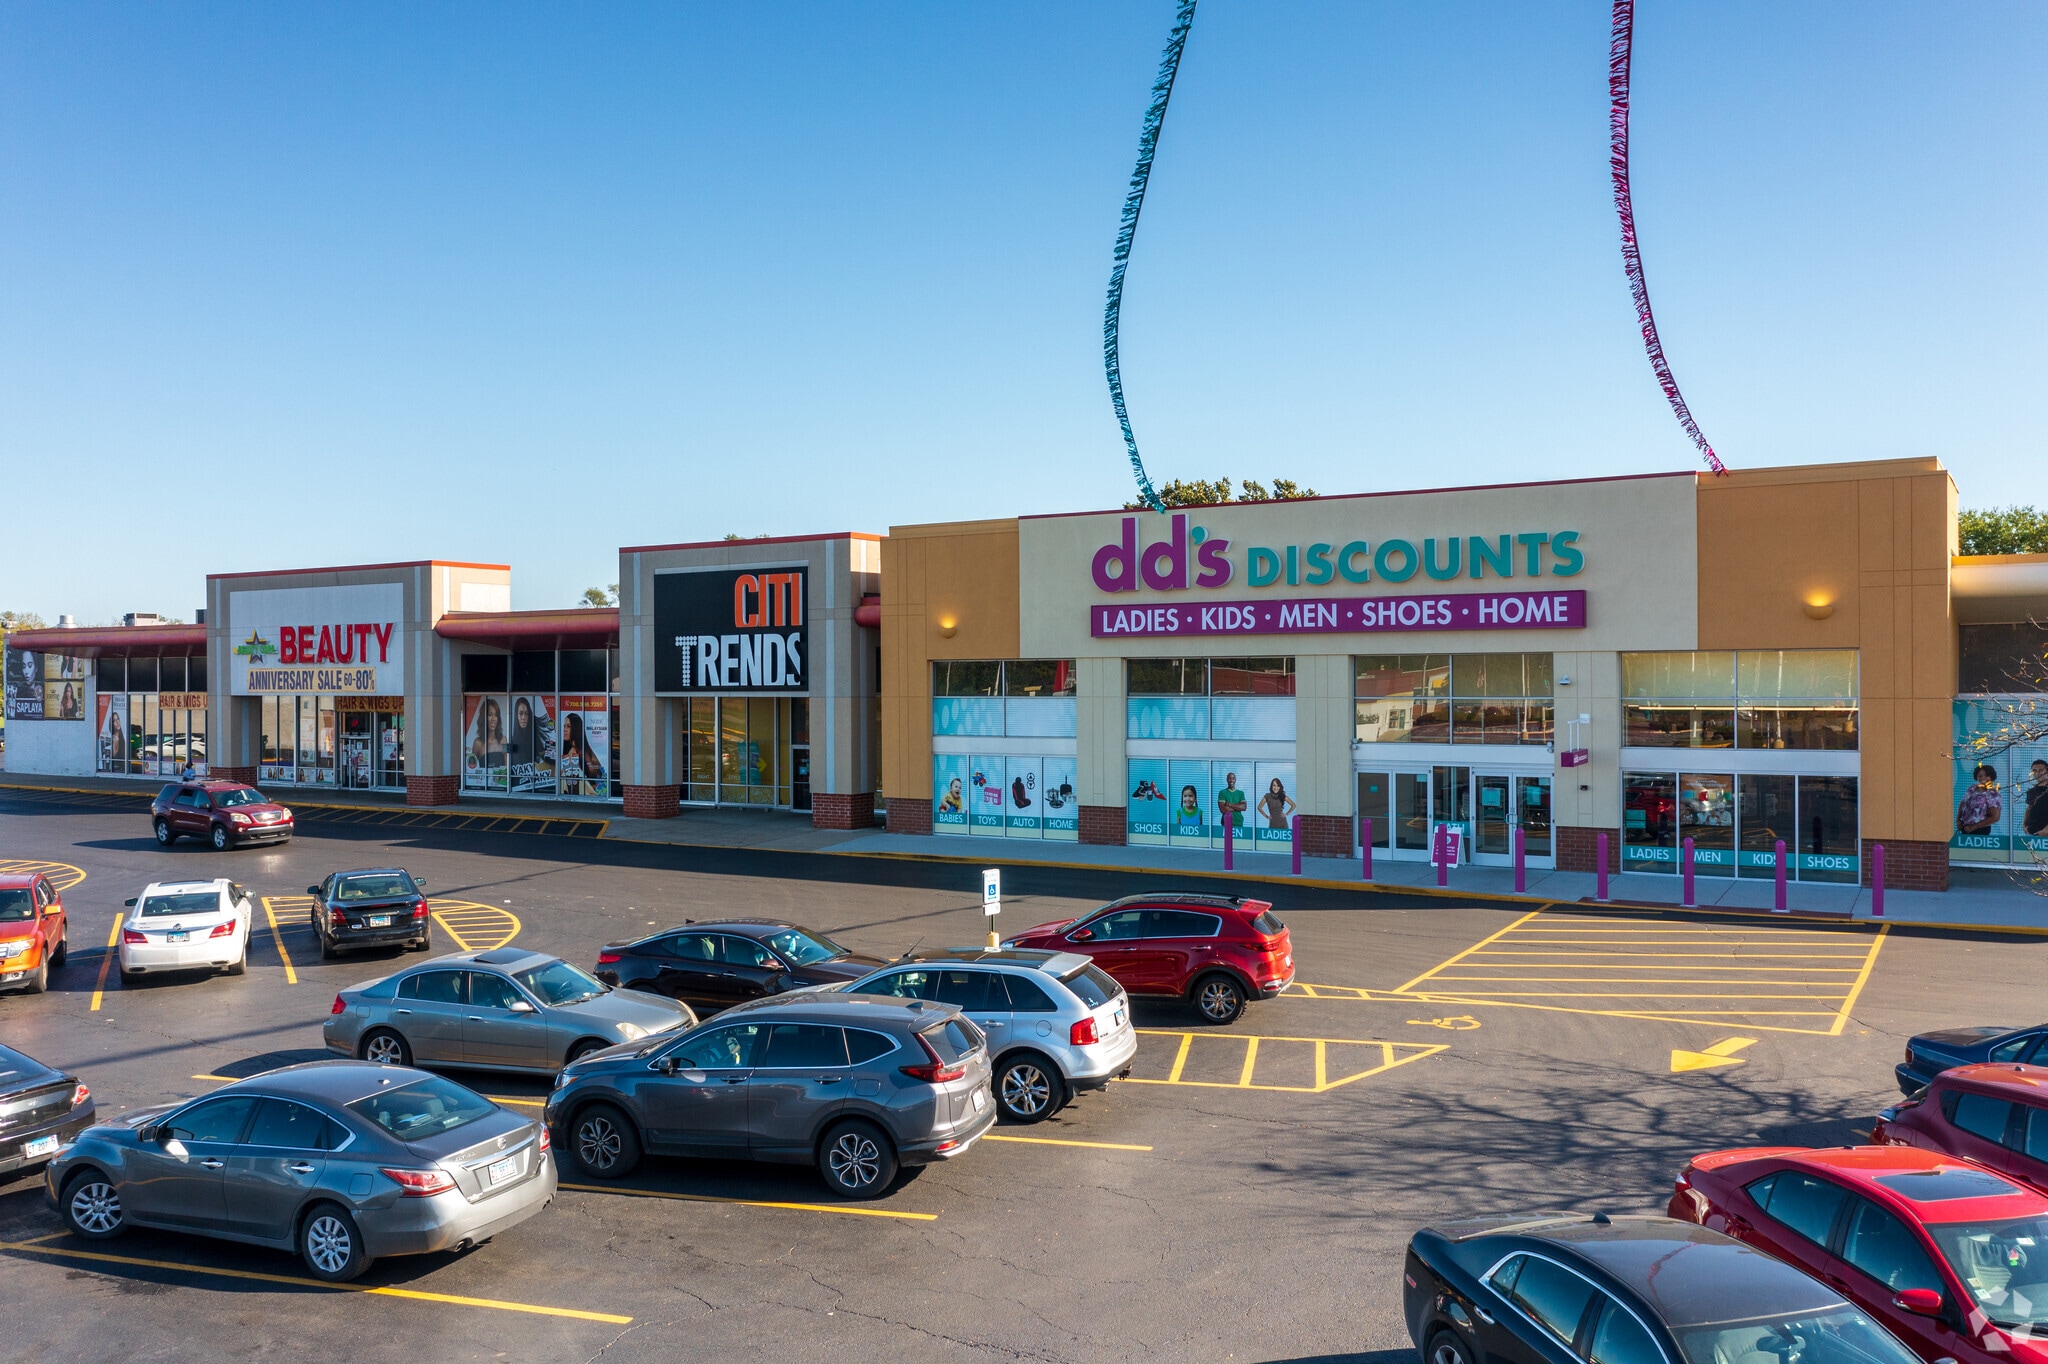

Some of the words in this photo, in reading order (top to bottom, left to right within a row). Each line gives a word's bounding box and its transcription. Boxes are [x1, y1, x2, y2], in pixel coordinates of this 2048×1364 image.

[1091, 514, 1235, 593] dd's
[1247, 531, 1585, 587] DISCOUNTS
[735, 572, 803, 628] CITI
[1103, 608, 1179, 633] LADIES
[1201, 605, 1256, 630] KIDS
[1279, 603, 1337, 628] MEN
[1362, 600, 1451, 626] SHOES
[1479, 596, 1568, 624] HOME
[280, 623, 394, 664] BEAUTY
[675, 632, 801, 687] TRENDS
[249, 670, 314, 690] ANNIVERSARY
[318, 670, 342, 690] SALE
[160, 695, 175, 708] HAIR
[176, 695, 181, 708] &
[184, 695, 200, 708] WIGS
[337, 696, 356, 709] HAIR
[368, 696, 390, 709] WIGS
[940, 814, 962, 824] BABIES
[978, 816, 996, 825] TOYS
[1013, 818, 1034, 827] AUTO
[1049, 820, 1073, 829] HOME
[1134, 823, 1162, 834] SHOES
[1180, 826, 1199, 836] KIDS
[1223, 828, 1243, 838] EN
[1262, 829, 1292, 840] LADIES
[1958, 836, 2000, 848] LADIES
[1630, 848, 1669, 860] LADIES
[1694, 851, 1721, 862] MEN
[1807, 856, 1849, 869] SHOES
